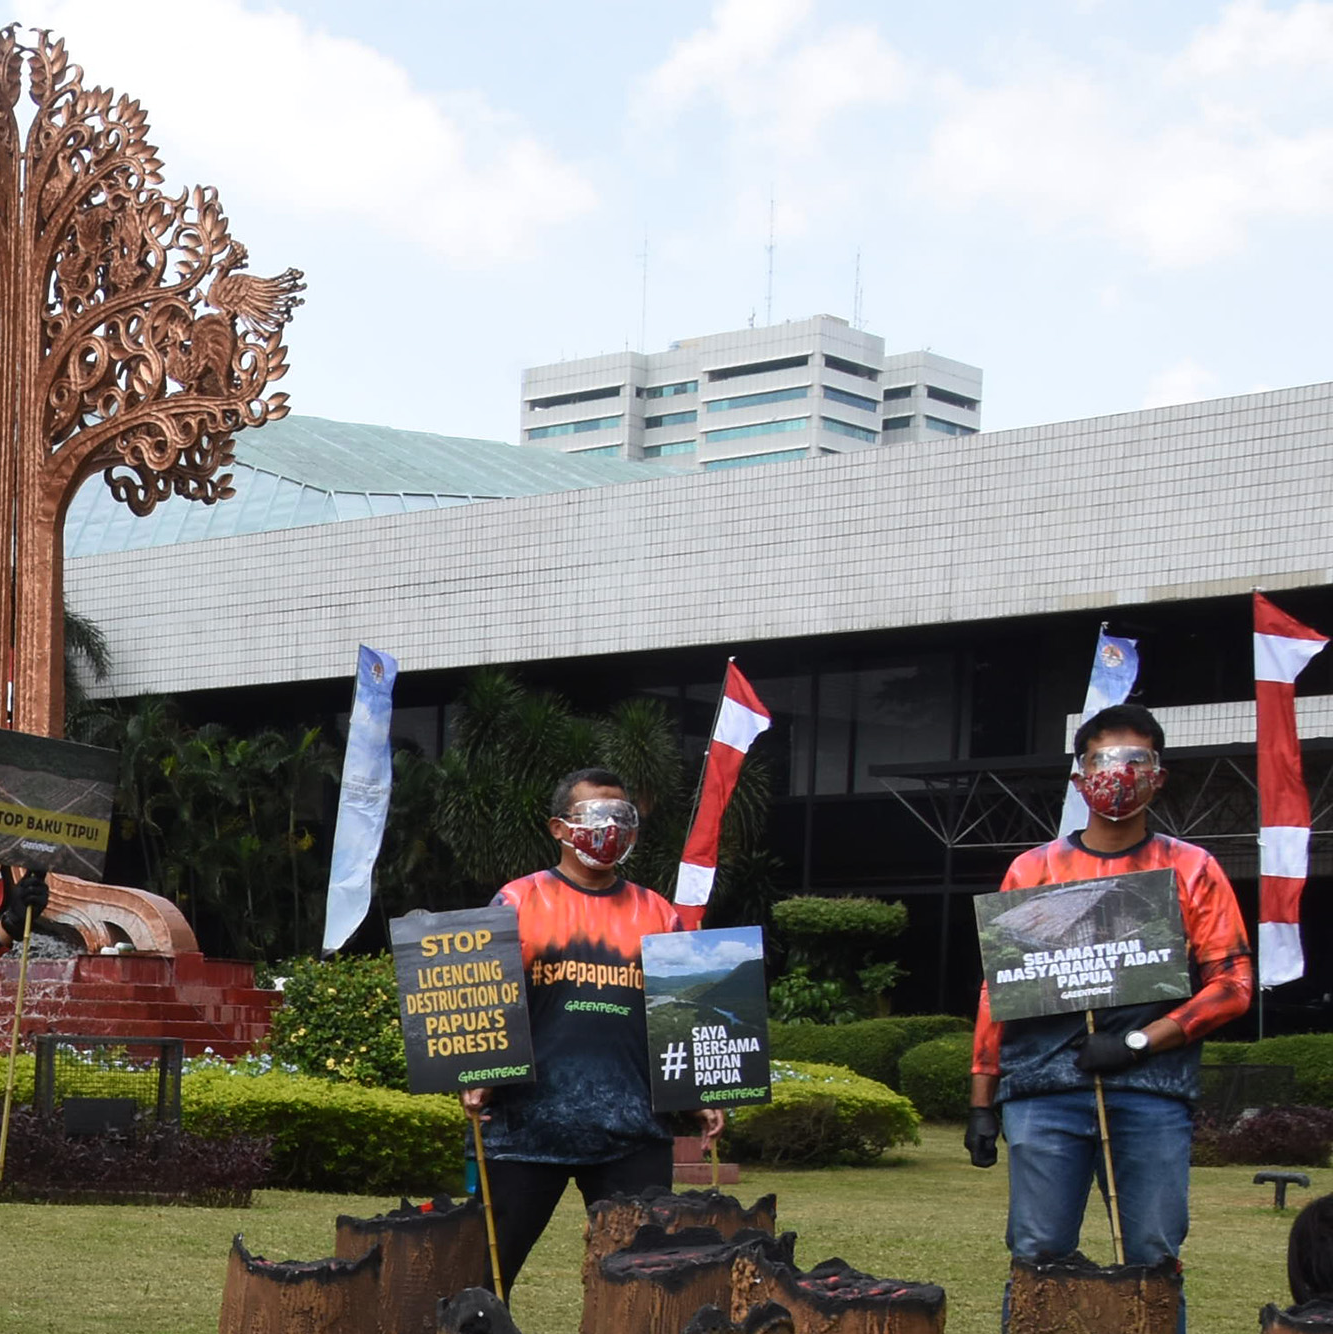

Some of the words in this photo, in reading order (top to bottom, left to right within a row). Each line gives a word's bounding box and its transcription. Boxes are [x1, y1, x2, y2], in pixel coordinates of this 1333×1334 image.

[26, 816, 63, 835] BAKU
[65, 822, 99, 841] TIPU!
[420, 929, 492, 957] STOP
[1023, 939, 1141, 967] SELAMATKAN
[417, 960, 503, 990] LICENCING
[996, 956, 1119, 984] MASYARAKAT
[1123, 949, 1172, 967] ADAT
[1057, 970, 1113, 988] PAPUA
[406, 985, 498, 1015] DESTRUCTION
[501, 982, 520, 1005] OF
[564, 1000, 631, 1016] GREENPEACE
[425, 1009, 505, 1036] PAPUA'S
[691, 1025, 727, 1041] SAYA
[427, 1031, 509, 1058] FORESTS
[693, 1037, 760, 1056] BERSAMA
[694, 1054, 741, 1071] HUTAN
[458, 1064, 531, 1084] GREENPEACE
[695, 1069, 741, 1086] PAPUA
[700, 1086, 768, 1103] GREENPEACE
